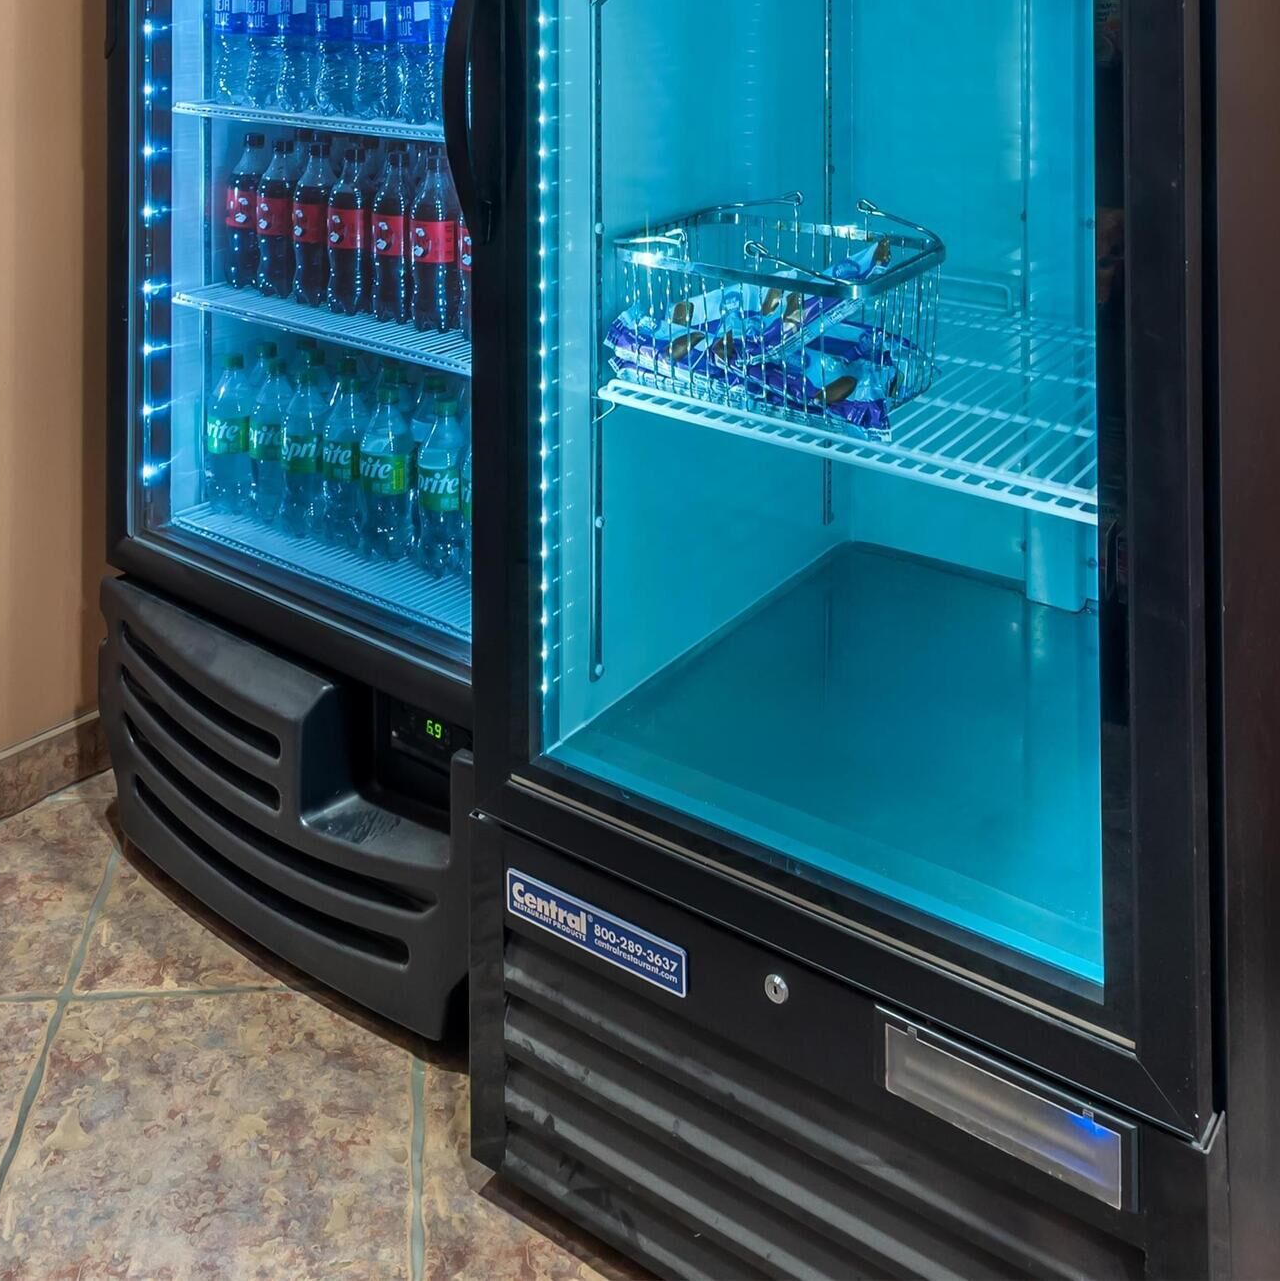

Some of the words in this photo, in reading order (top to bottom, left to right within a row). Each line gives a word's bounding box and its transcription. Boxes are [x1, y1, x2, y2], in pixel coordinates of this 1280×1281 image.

[512, 882, 587, 935] Central
[513, 900, 552, 924] RESTAURANT
[553, 920, 587, 942] PRODUCTS
[594, 924, 679, 973] 800-289-3637
[594, 938, 678, 984] centralrestaurant.com
